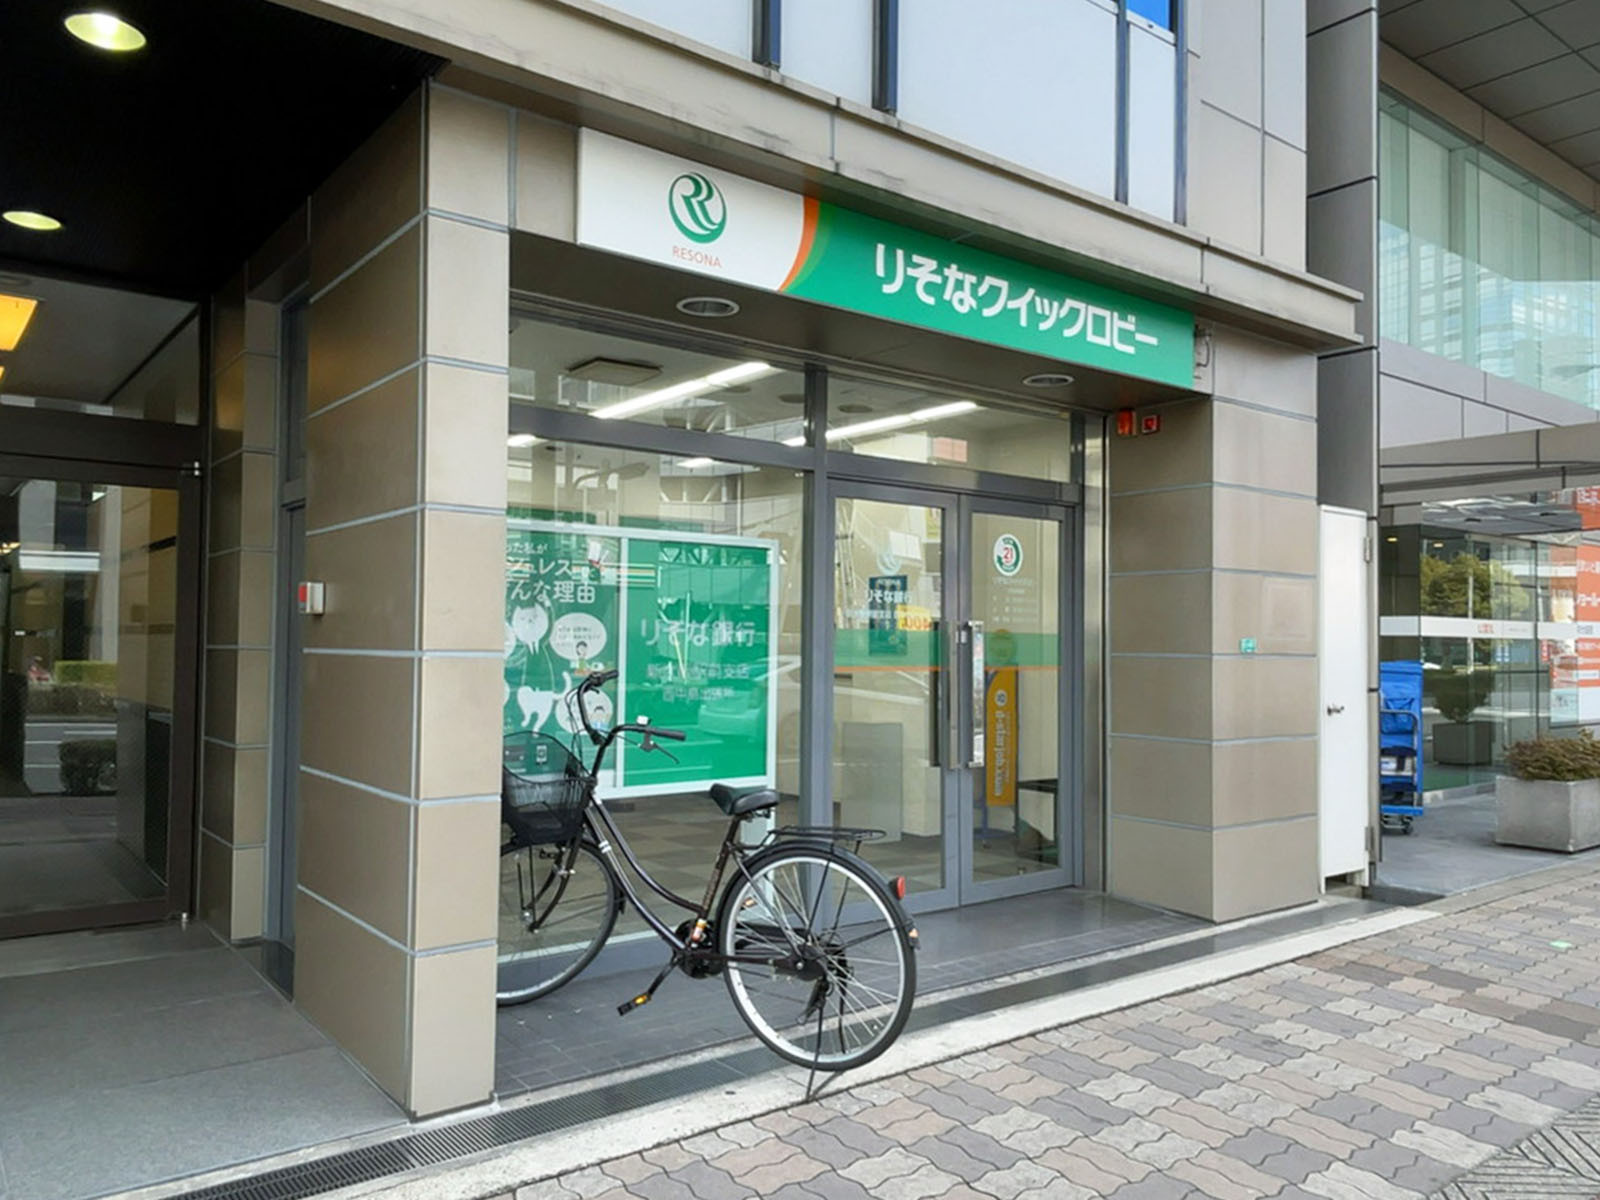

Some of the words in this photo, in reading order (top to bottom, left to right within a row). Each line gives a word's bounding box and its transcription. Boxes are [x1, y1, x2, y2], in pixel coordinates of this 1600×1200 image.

[672, 245, 722, 267] RESONA
[875, 242, 1158, 354] りそなクイックロビー
